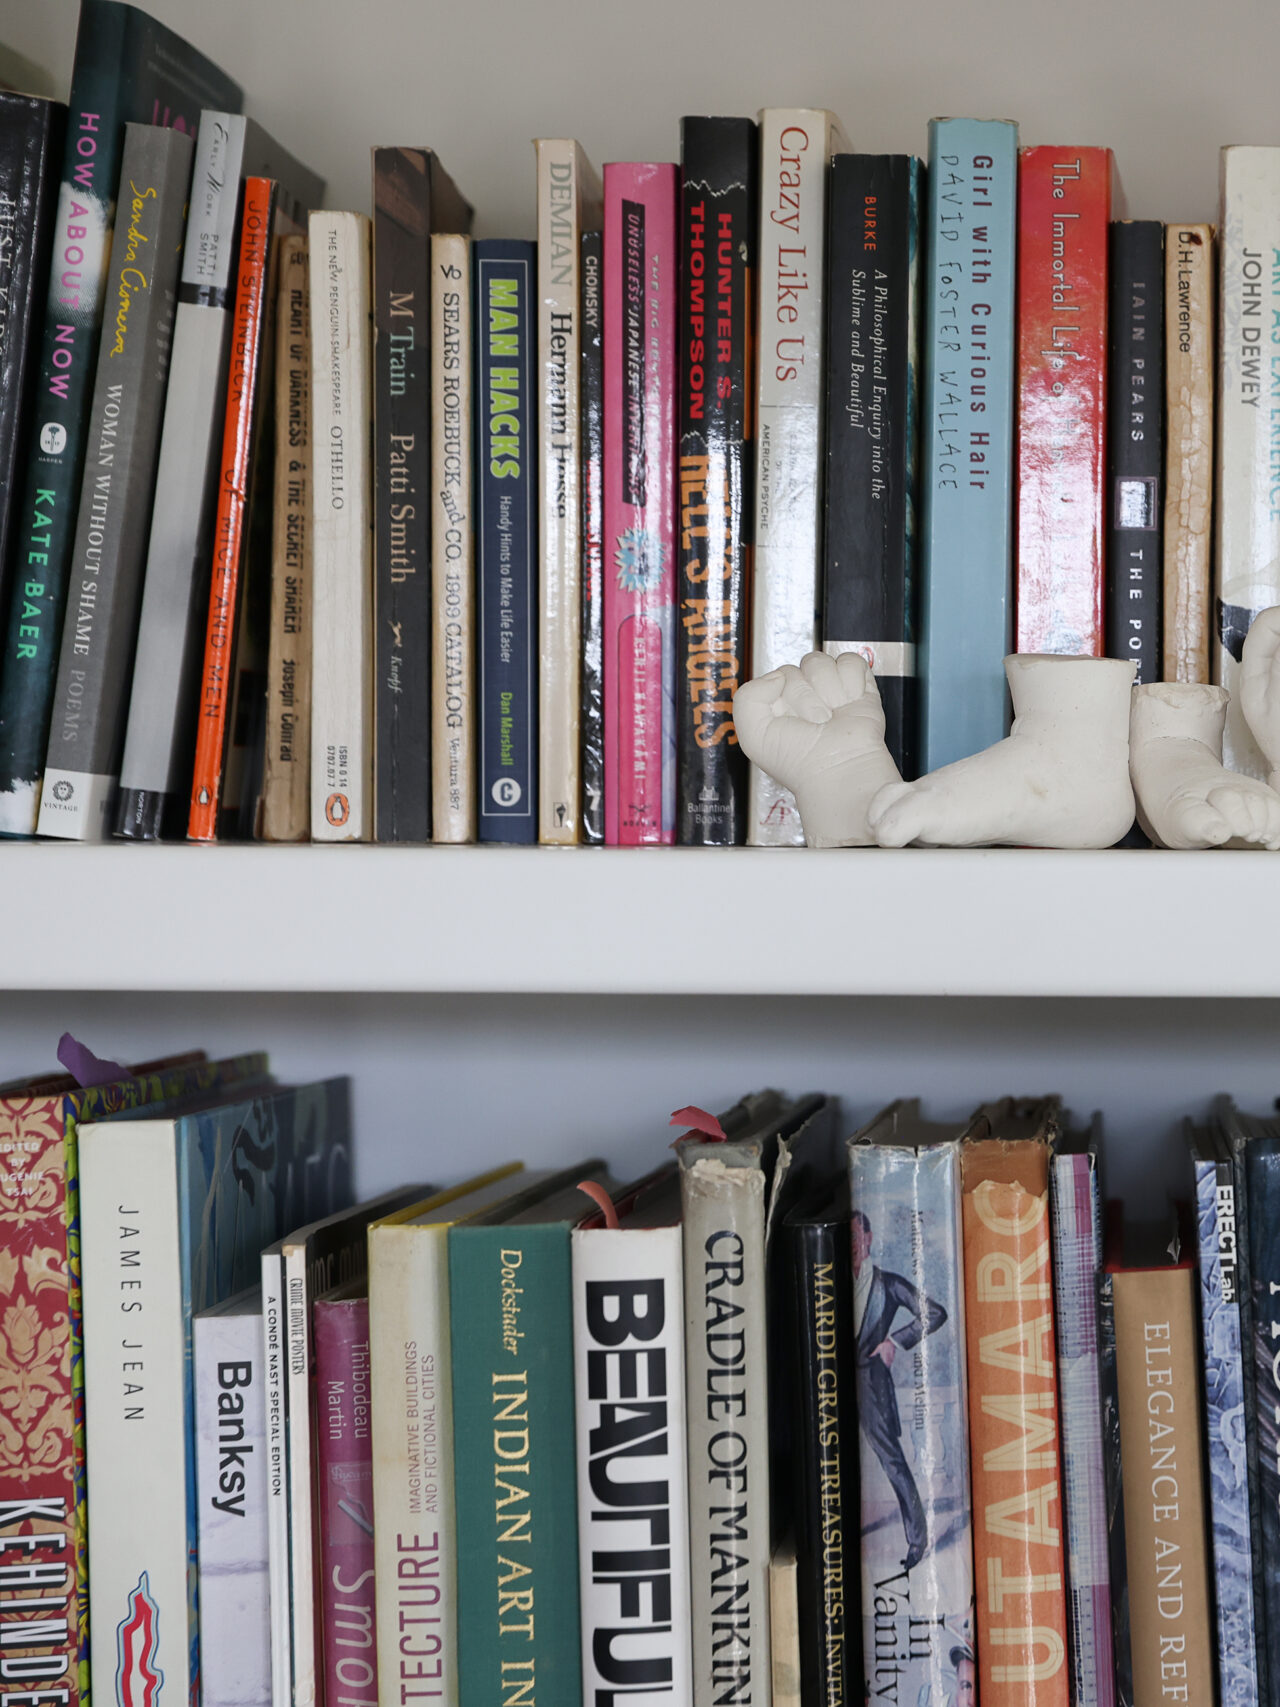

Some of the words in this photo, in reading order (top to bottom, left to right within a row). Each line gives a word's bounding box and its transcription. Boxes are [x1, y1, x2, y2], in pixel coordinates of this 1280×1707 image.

[72, 112, 100, 188] HOW
[769, 126, 809, 236] Crazy
[971, 155, 993, 208] Girl
[58, 200, 89, 310] ABOUT
[197, 232, 209, 276] SMITH
[206, 234, 220, 278] PATTI
[627, 213, 641, 303] UNUSELESS
[864, 196, 877, 252] BURKE
[971, 226, 992, 284] with
[388, 291, 414, 317] M
[585, 255, 598, 328] CHOMSKY
[688, 200, 705, 420] THOMPSON
[717, 212, 732, 364] HUNTER
[777, 245, 808, 324] Like
[1131, 282, 1145, 341] IAIN
[1241, 248, 1262, 317] JOHN
[488, 279, 519, 357] MAN
[627, 308, 641, 387] JAPANESE
[47, 324, 76, 400] NOW
[388, 325, 415, 396] Train
[717, 375, 732, 410] S.
[776, 338, 806, 383] Us
[970, 302, 992, 414] Curious
[1240, 326, 1261, 409] DEWEY
[489, 367, 520, 479] HACKS
[1131, 359, 1145, 441] PEARS
[330, 425, 344, 511] OTHELLO
[388, 433, 415, 494] Patti
[760, 424, 770, 482] AMERICAN
[968, 431, 990, 490] Hair
[26, 488, 57, 566] KATE
[497, 495, 513, 531] Handy
[760, 485, 769, 530] PSYCHE
[388, 503, 416, 584] Smith
[499, 533, 513, 562] Hints
[500, 564, 512, 575] to
[1129, 549, 1143, 600] THE
[16, 582, 46, 660] BAER
[500, 577, 513, 608] Make
[500, 610, 513, 629] Life
[386, 656, 403, 695] Knopf
[499, 631, 512, 663] Easier
[500, 692, 514, 714] Dan
[500, 717, 514, 766] Marshall
[1216, 1184, 1239, 1264] ERECT
[118, 1205, 142, 1313] JAMES
[289, 1277, 304, 1306] CRIME
[1219, 1266, 1237, 1304] Lab.
[267, 1295, 277, 1304] A
[267, 1308, 280, 1350] CONDÉ
[290, 1307, 305, 1337] MOVIE
[500, 1248, 525, 1356] Dockstader
[705, 1230, 747, 1422] CRADLE
[813, 1262, 837, 1360] MARDI
[121, 1339, 145, 1421] JEAN
[268, 1354, 278, 1386] NAST
[290, 1339, 306, 1375] POSTERS
[351, 1340, 371, 1439] Thibodeau
[404, 1340, 420, 1419] BUILDINGS
[421, 1355, 435, 1401] CITIES
[212, 1359, 254, 1518] Banksy
[269, 1391, 280, 1442] SPECIAL
[327, 1380, 346, 1440] Martin
[423, 1405, 437, 1479] FICTIONAL
[817, 1368, 840, 1447] GRAS
[1143, 1320, 1181, 1523] ELEGANCE
[271, 1446, 282, 1496] EDITION
[406, 1425, 422, 1514] IMAGINATIVE
[585, 1277, 673, 1707] BEAUTIFUL
[707, 1431, 748, 1494] OF
[425, 1483, 438, 1514] AND
[819, 1454, 845, 1625] TREASURES:
[0, 1496, 69, 1707] KEHINDE
[1154, 1536, 1185, 1619] AND
[908, 1613, 946, 1663] In
